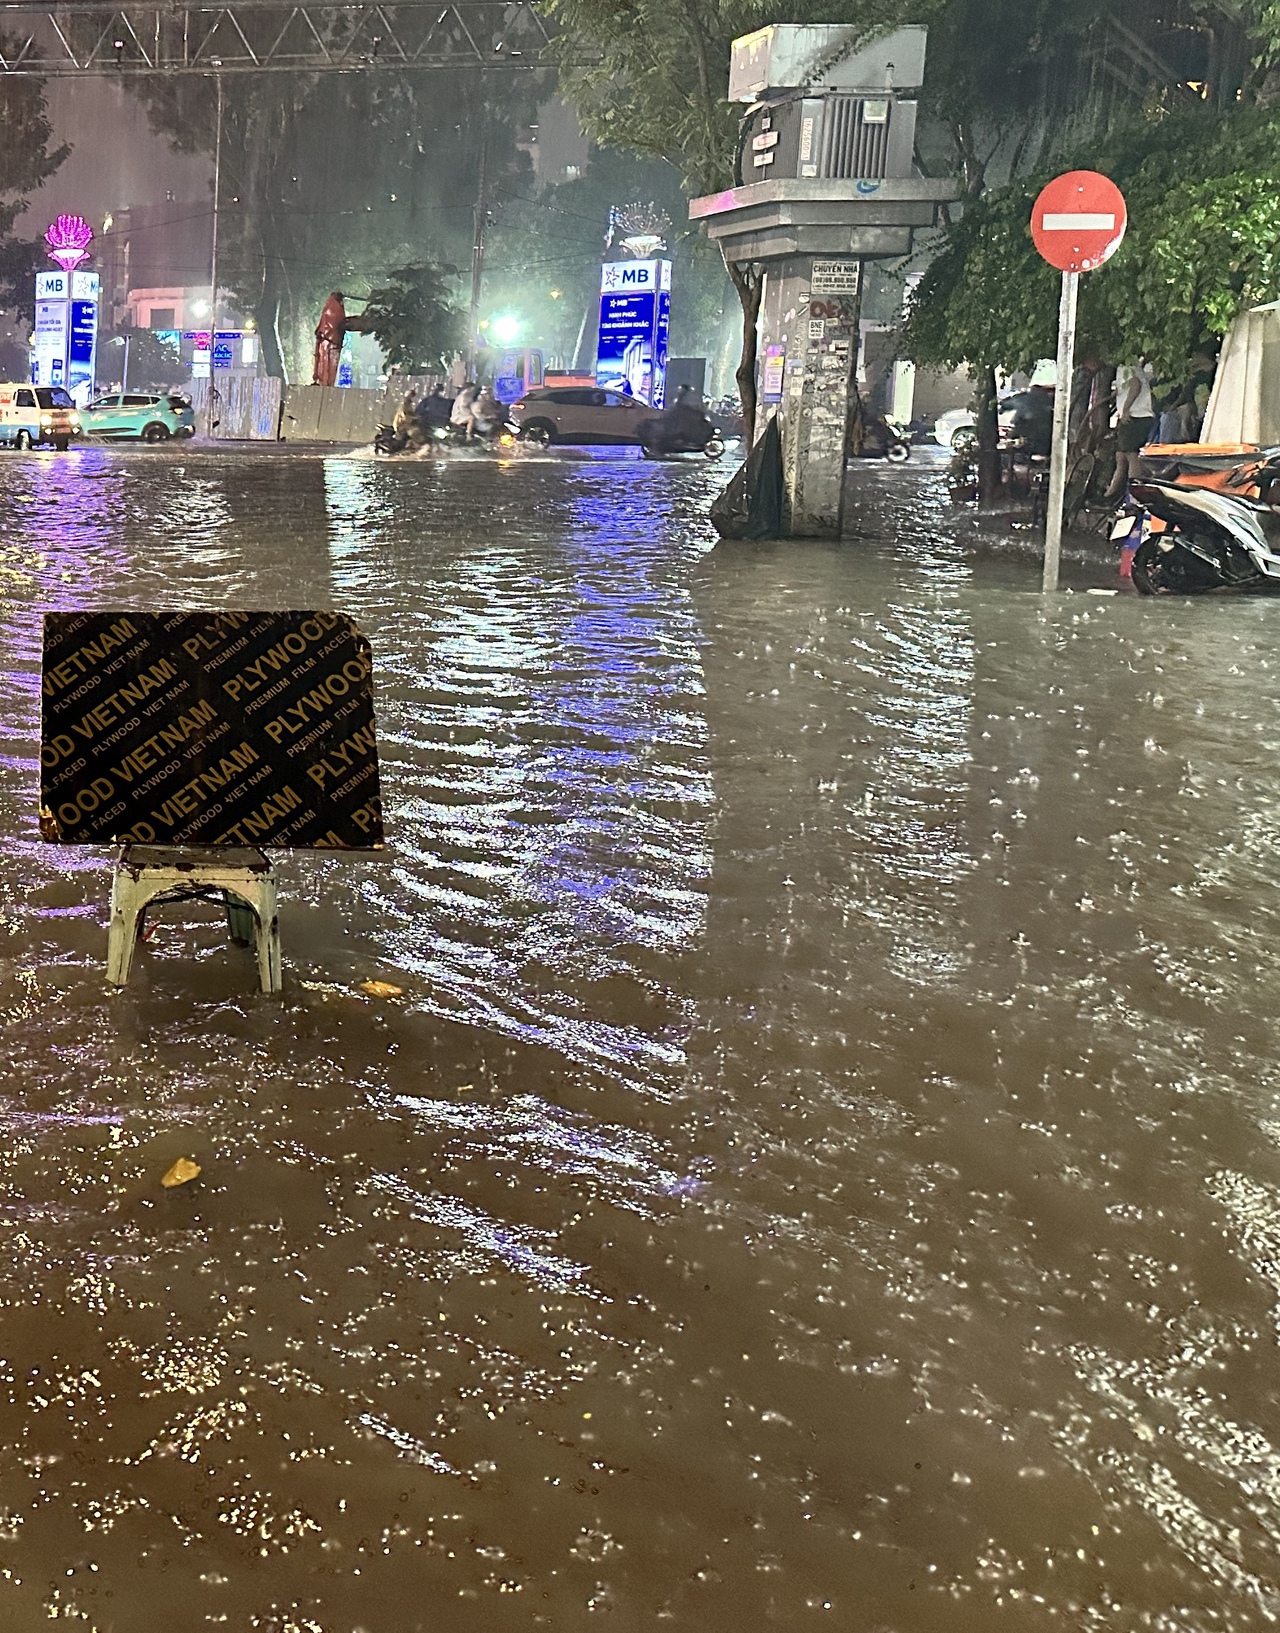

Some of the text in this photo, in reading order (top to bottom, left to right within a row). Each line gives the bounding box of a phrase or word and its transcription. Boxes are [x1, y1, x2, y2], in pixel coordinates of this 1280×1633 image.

[46, 279, 63, 292] MB
[621, 269, 649, 284] MB
[42, 617, 139, 697] VIETNAM
[66, 615, 89, 633] VIET
[52, 617, 275, 786] FACED PLYWOOD VIET NAM PREMIUM FILM
[53, 675, 102, 714] PLYWOOD
[103, 656, 126, 675] VIET
[125, 639, 151, 660] NAM
[71, 658, 178, 739] VIETNAM
[110, 699, 219, 782] VIETNAM
[222, 612, 338, 702] PLYWOOD
[91, 801, 127, 830] FACED
[131, 759, 182, 800] PLYWOOD
[183, 739, 207, 760] VIET
[205, 721, 231, 744] NAM
[244, 677, 291, 715] PREMIUM
[291, 657, 318, 679] FILM
[317, 630, 351, 659] FACED
[151, 741, 260, 827] VIETNAM
[172, 803, 223, 843] PLYWOOD
[224, 783, 249, 803] VIET
[248, 765, 273, 786] NAM
[286, 719, 334, 758] PREMIUM
[333, 699, 360, 721] FILM
[291, 809, 317, 830] NAM
[329, 763, 378, 802] PREMIUM
